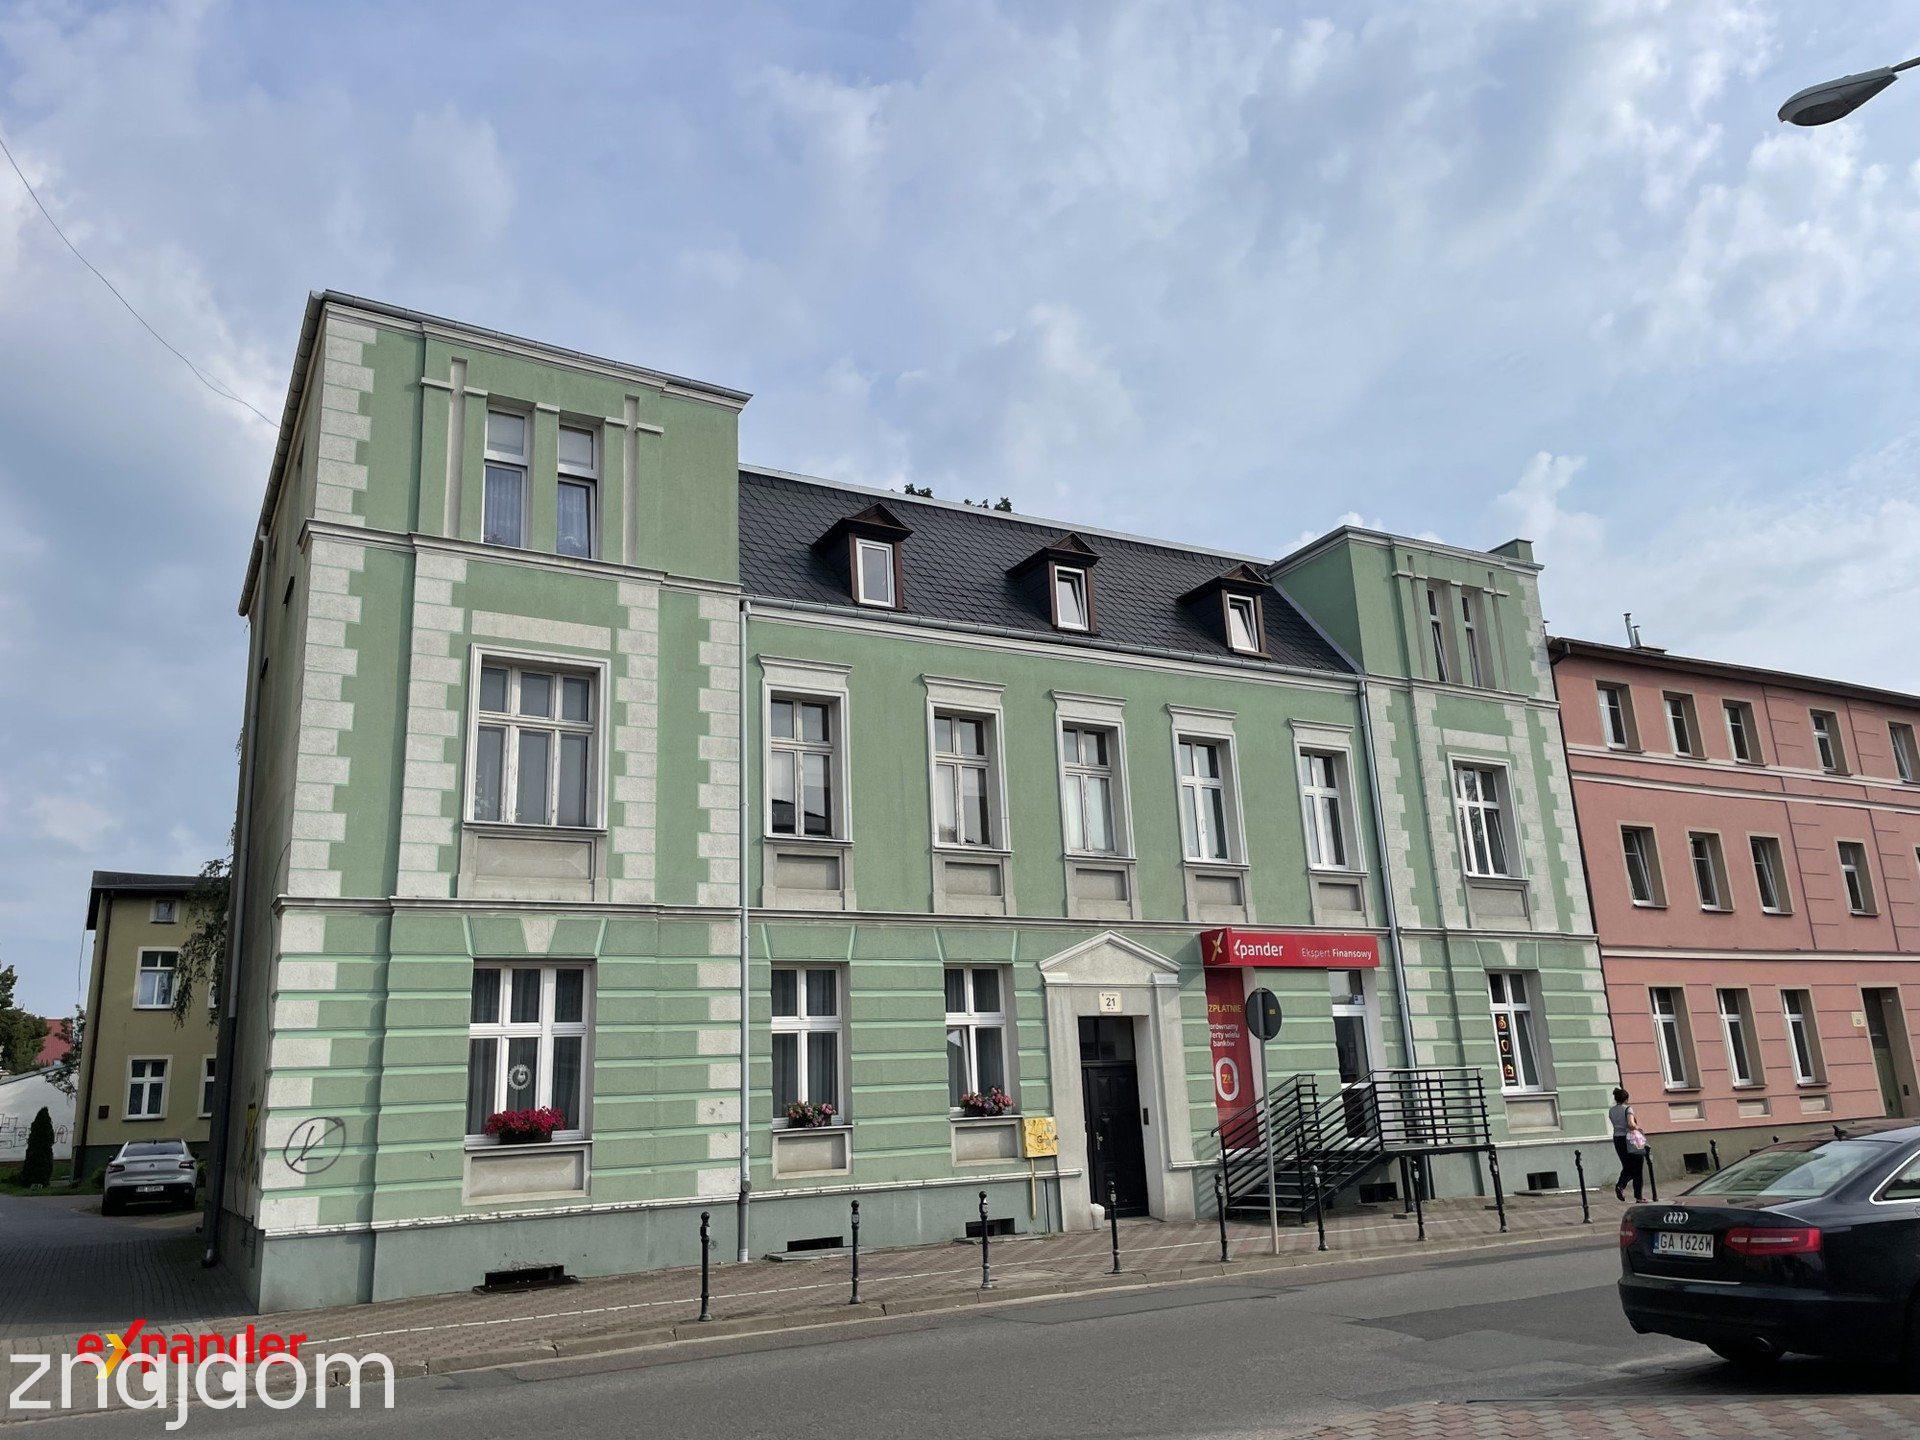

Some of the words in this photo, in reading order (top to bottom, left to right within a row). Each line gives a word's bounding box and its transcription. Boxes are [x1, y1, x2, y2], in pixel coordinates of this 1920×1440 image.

[1301, 948, 1330, 959] Ekspert
[1332, 948, 1372, 960] Finansowy
[1105, 997, 1116, 1006] 21
[1660, 1233, 1675, 1249] GA
[1680, 1234, 1712, 1251] 1626W
